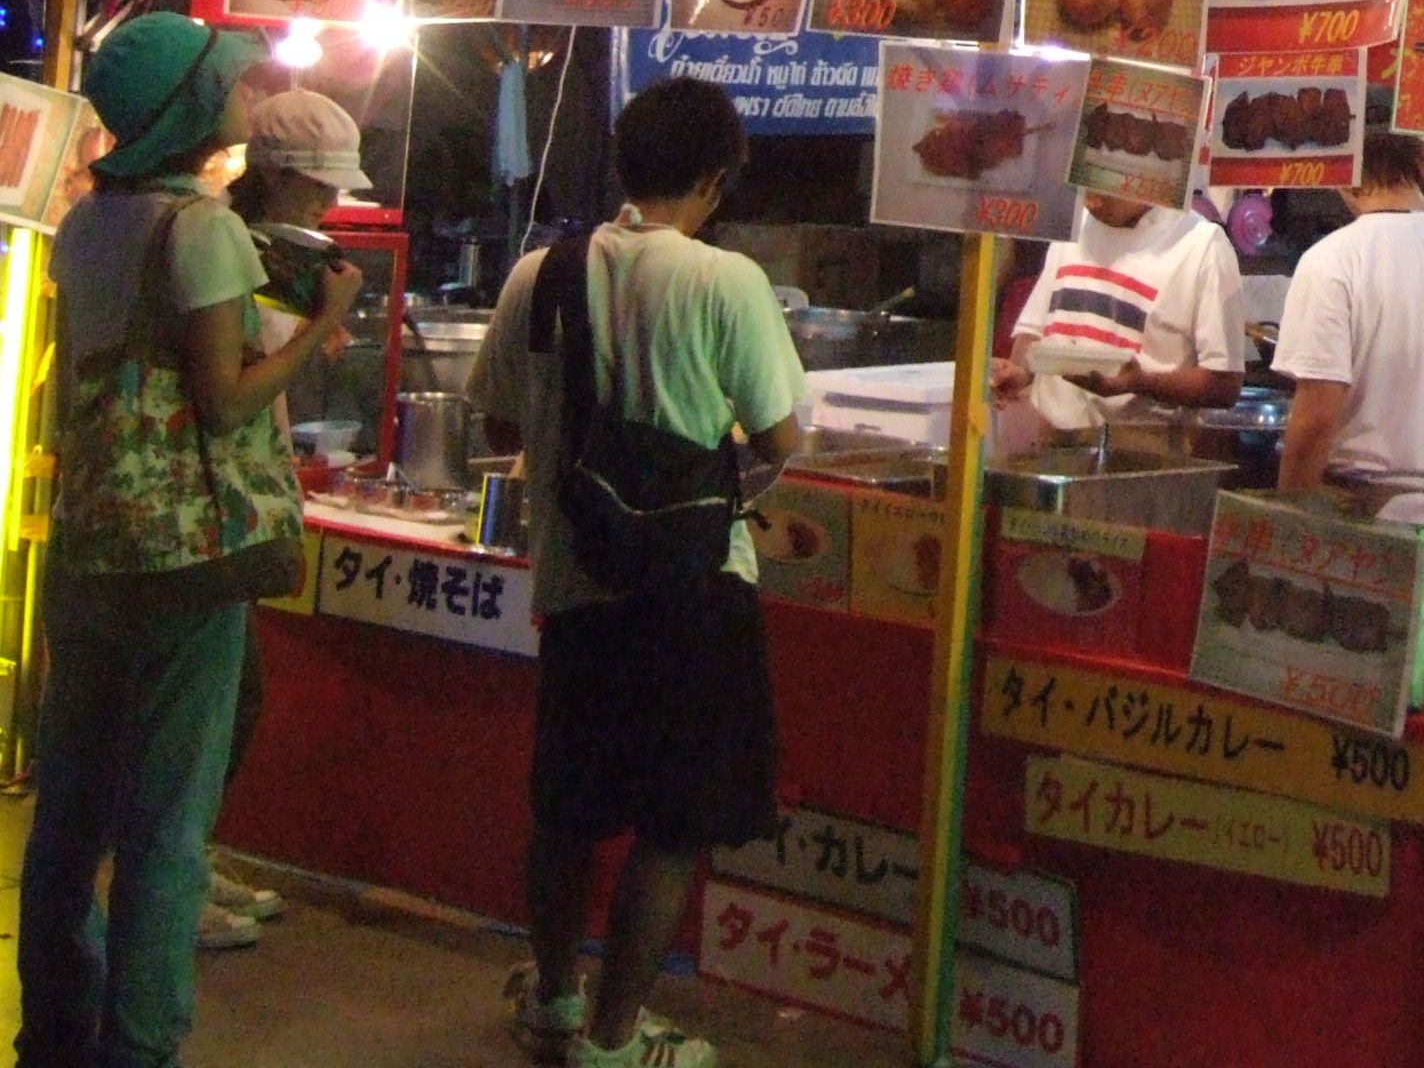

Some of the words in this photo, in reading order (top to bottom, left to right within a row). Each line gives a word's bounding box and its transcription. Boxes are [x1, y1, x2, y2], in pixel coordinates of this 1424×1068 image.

[1299, 11, 1360, 44] ¥700
[1277, 163, 1327, 184] ¥700
[976, 195, 1039, 231] ¥300
[333, 548, 504, 623] タイ・焼そば
[1000, 667, 1286, 761] タイ・バジルカレー
[1331, 735, 1411, 792] ¥500
[775, 817, 921, 885] イ・カレー
[1312, 820, 1383, 878] ¥500
[717, 901, 912, 1001] タイ・ラーメ
